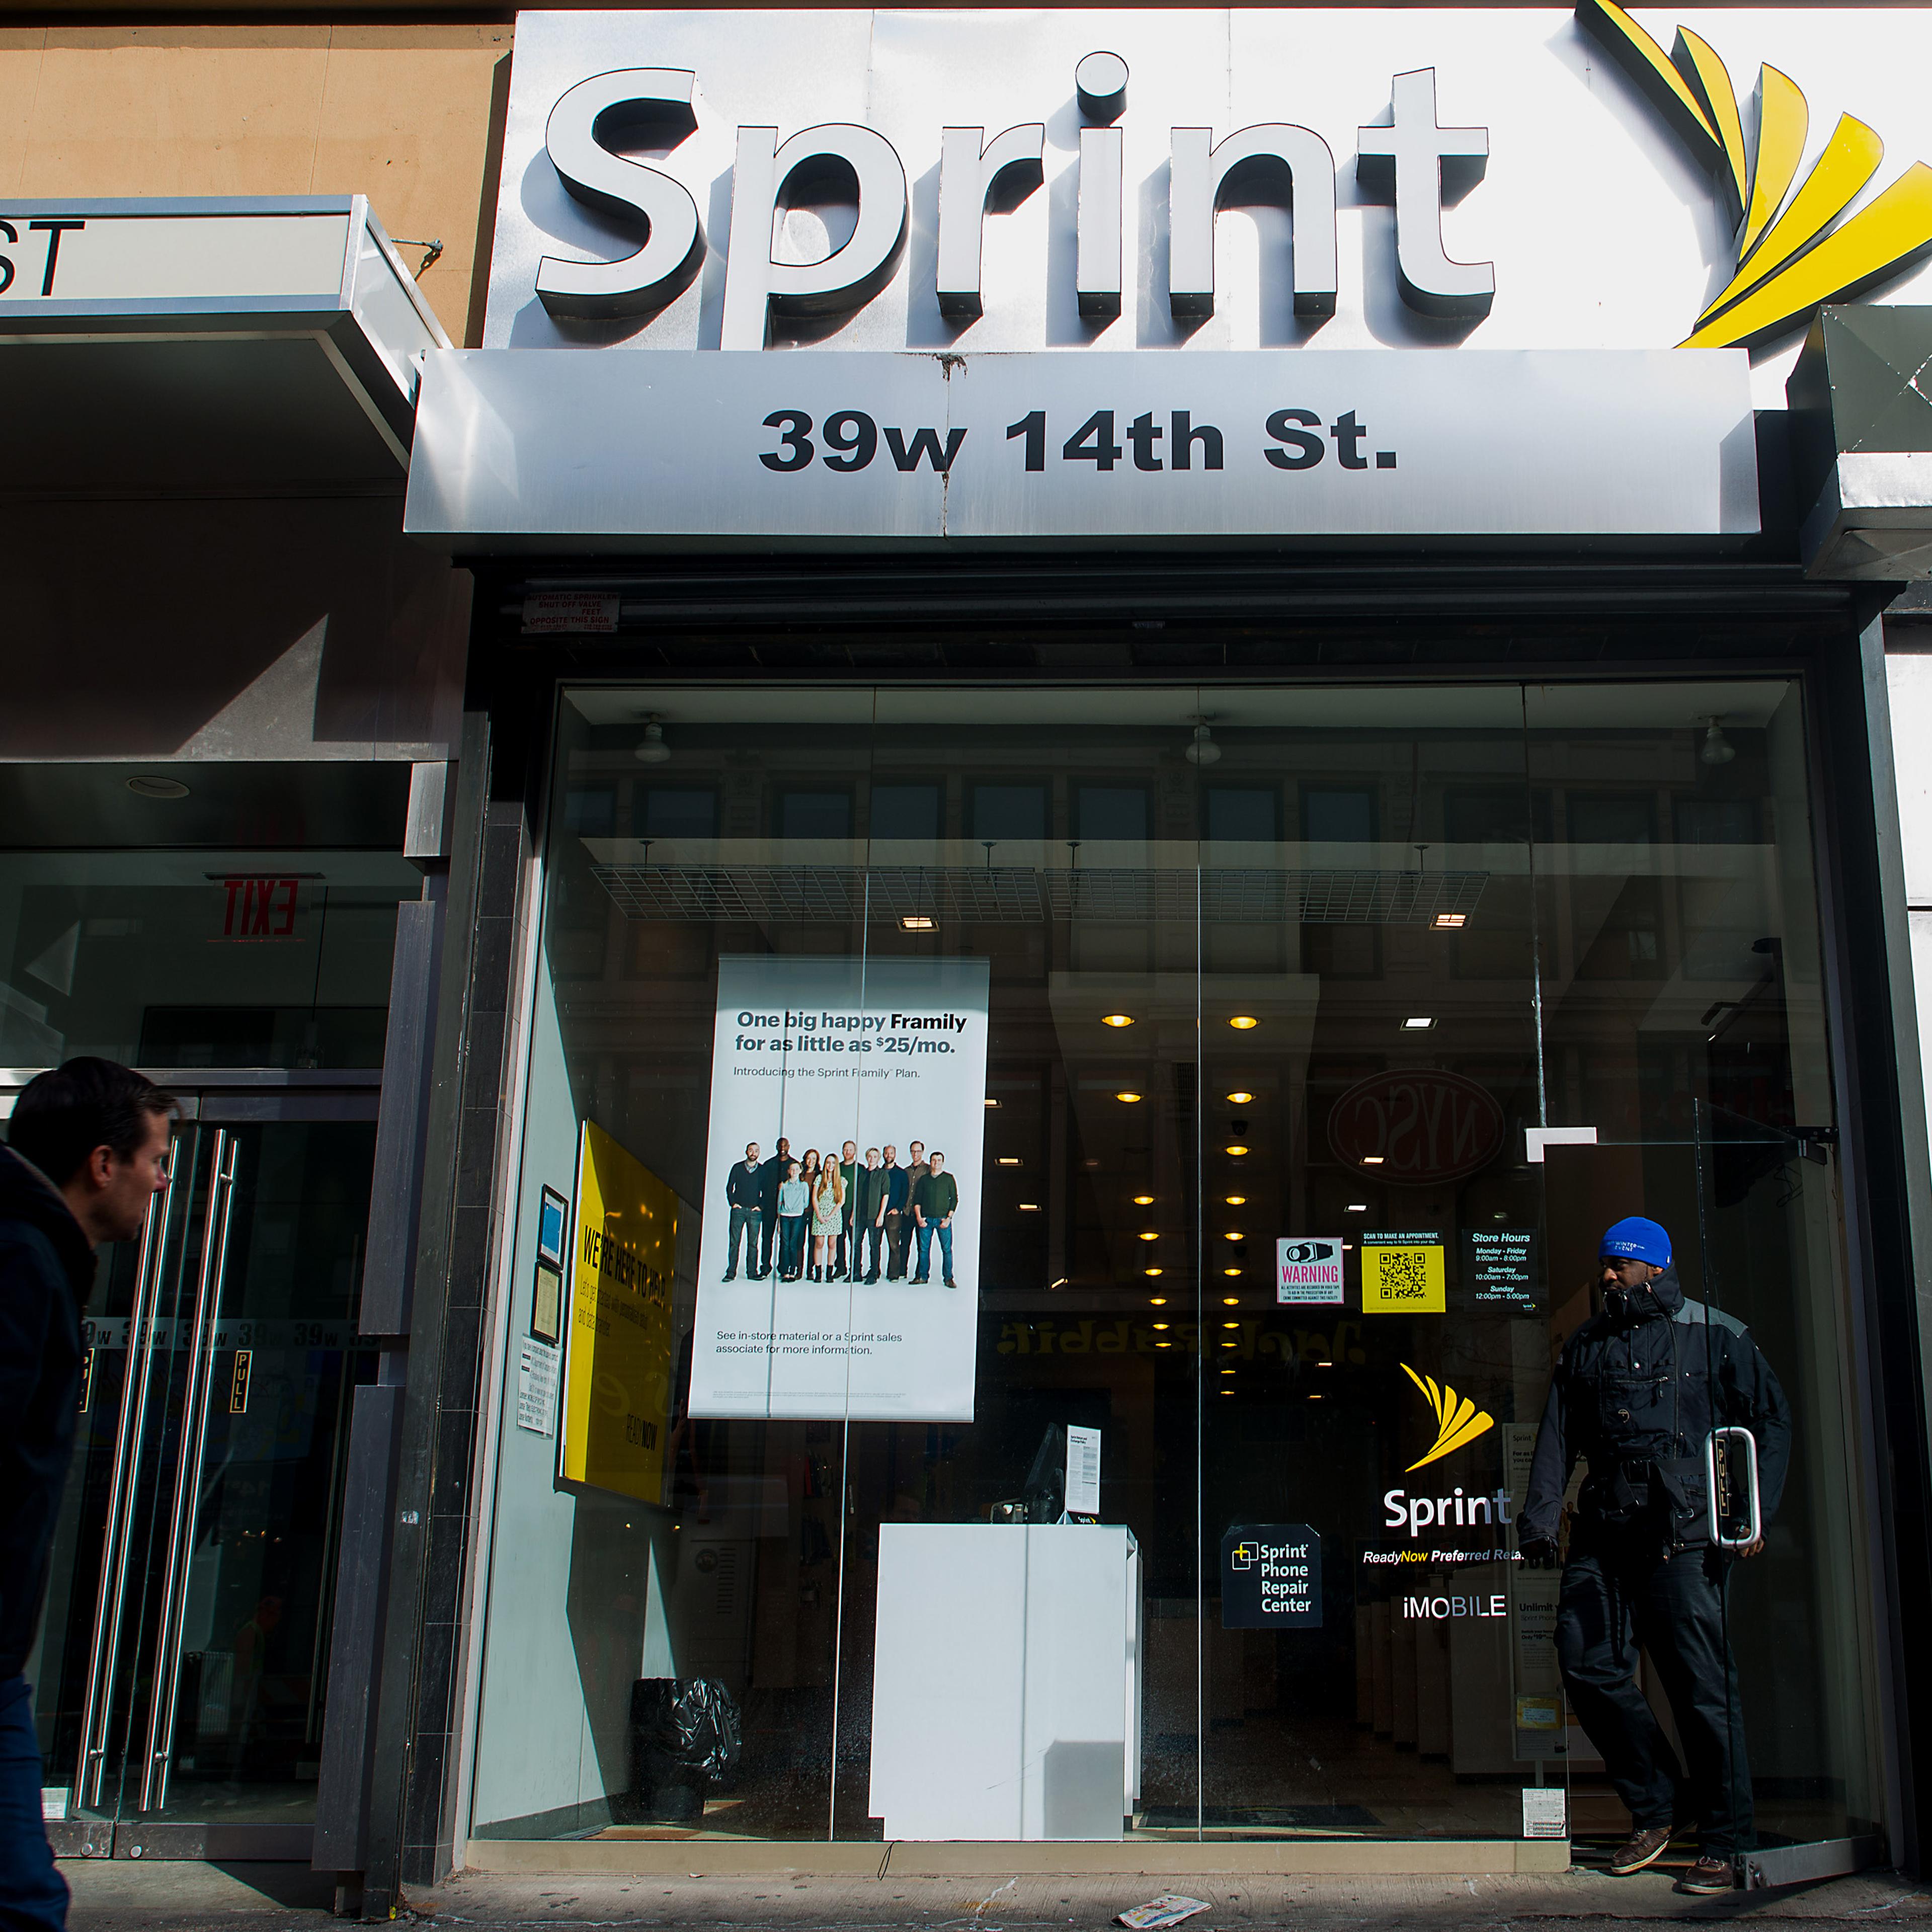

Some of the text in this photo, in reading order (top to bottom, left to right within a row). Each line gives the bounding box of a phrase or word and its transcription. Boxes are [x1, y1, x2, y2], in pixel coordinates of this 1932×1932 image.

[535, 50, 1496, 351] Sprint
[760, 409, 1398, 472] 39w 14th St.
[737, 1011, 967, 1033] One big happy Framily
[735, 1034, 955, 1056] for as little as $25/mo.
[734, 1067, 795, 1078] Introducing
[798, 1067, 815, 1077] the
[818, 1068, 849, 1080] Sprint
[896, 1069, 920, 1078] Plan.
[1472, 1233, 1530, 1242] Store Hours
[1281, 1265, 1338, 1283] WARNING
[717, 1331, 736, 1340] See
[739, 1331, 776, 1341] in-store
[779, 1331, 820, 1341] material
[844, 1332, 874, 1343] Sprint
[877, 1332, 902, 1342] sales
[716, 1344, 763, 1353] associate
[766, 1344, 780, 1353] for
[812, 1345, 872, 1355] information.
[233, 1354, 249, 1409] PULL
[1718, 1448, 1726, 1507] PULL
[1384, 1487, 1512, 1537] Sprint
[1260, 1544, 1309, 1562] Sprint
[1363, 1550, 1428, 1565] ReadyNow
[1431, 1549, 1491, 1562] Preferred
[1261, 1562, 1309, 1577] Phone
[1262, 1579, 1309, 1598] Repair
[1262, 1598, 1312, 1612] Center
[1404, 1595, 1506, 1619] iMOBILE
[1519, 1603, 1553, 1612] Unlimit
